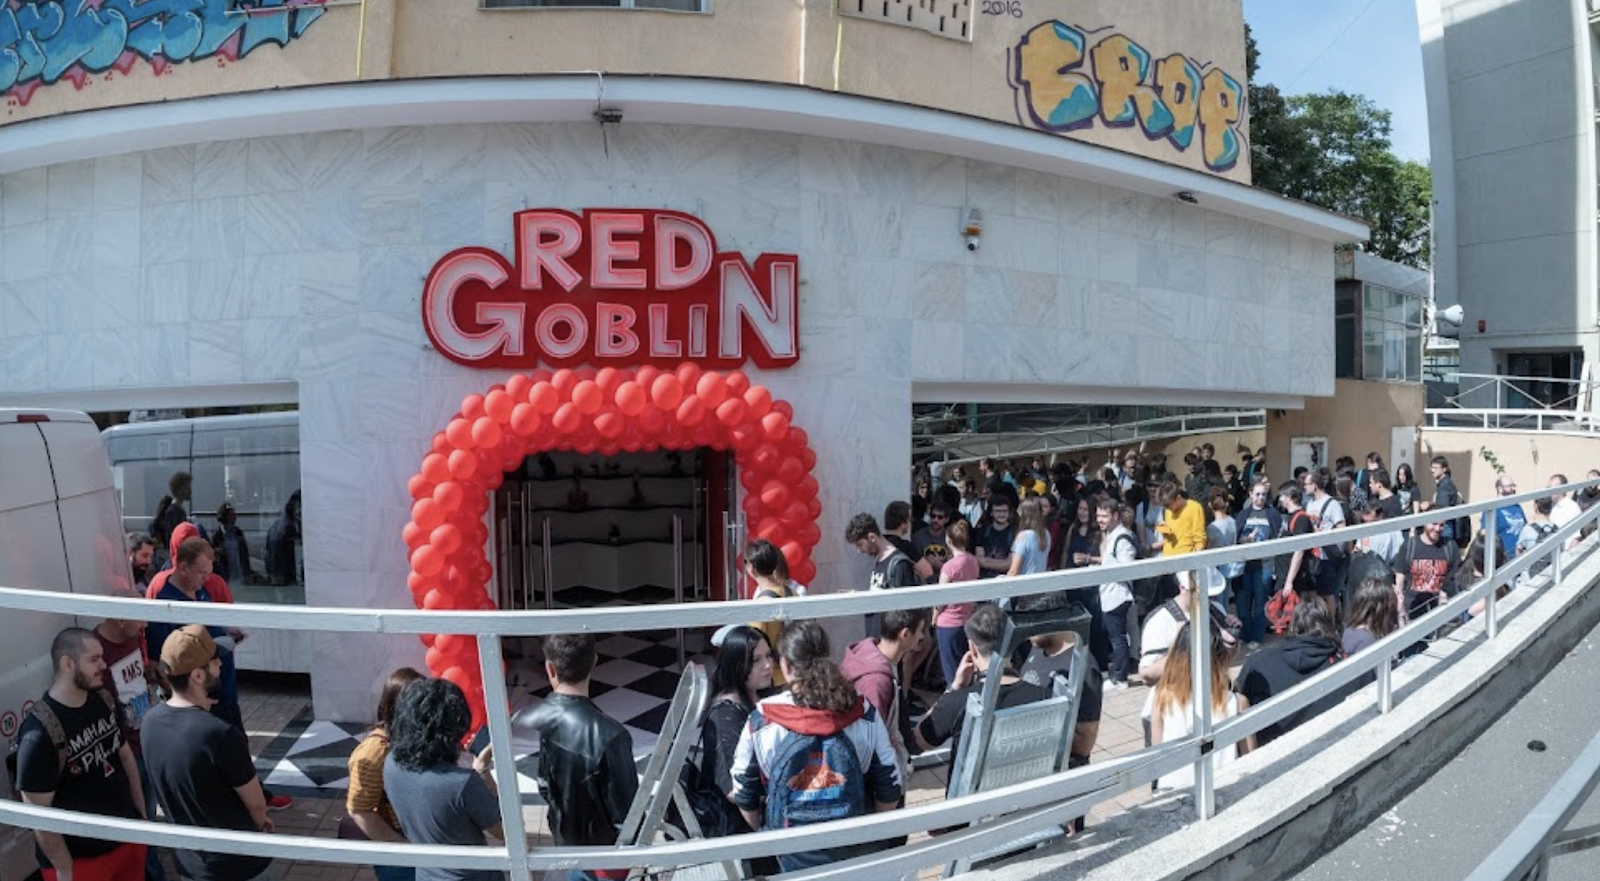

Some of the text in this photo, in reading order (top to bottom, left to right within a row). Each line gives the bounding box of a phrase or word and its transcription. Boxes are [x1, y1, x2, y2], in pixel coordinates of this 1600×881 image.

[981, 0, 1023, 19] 2016
[519, 212, 714, 293] RED
[424, 251, 797, 360] GOBLIN
